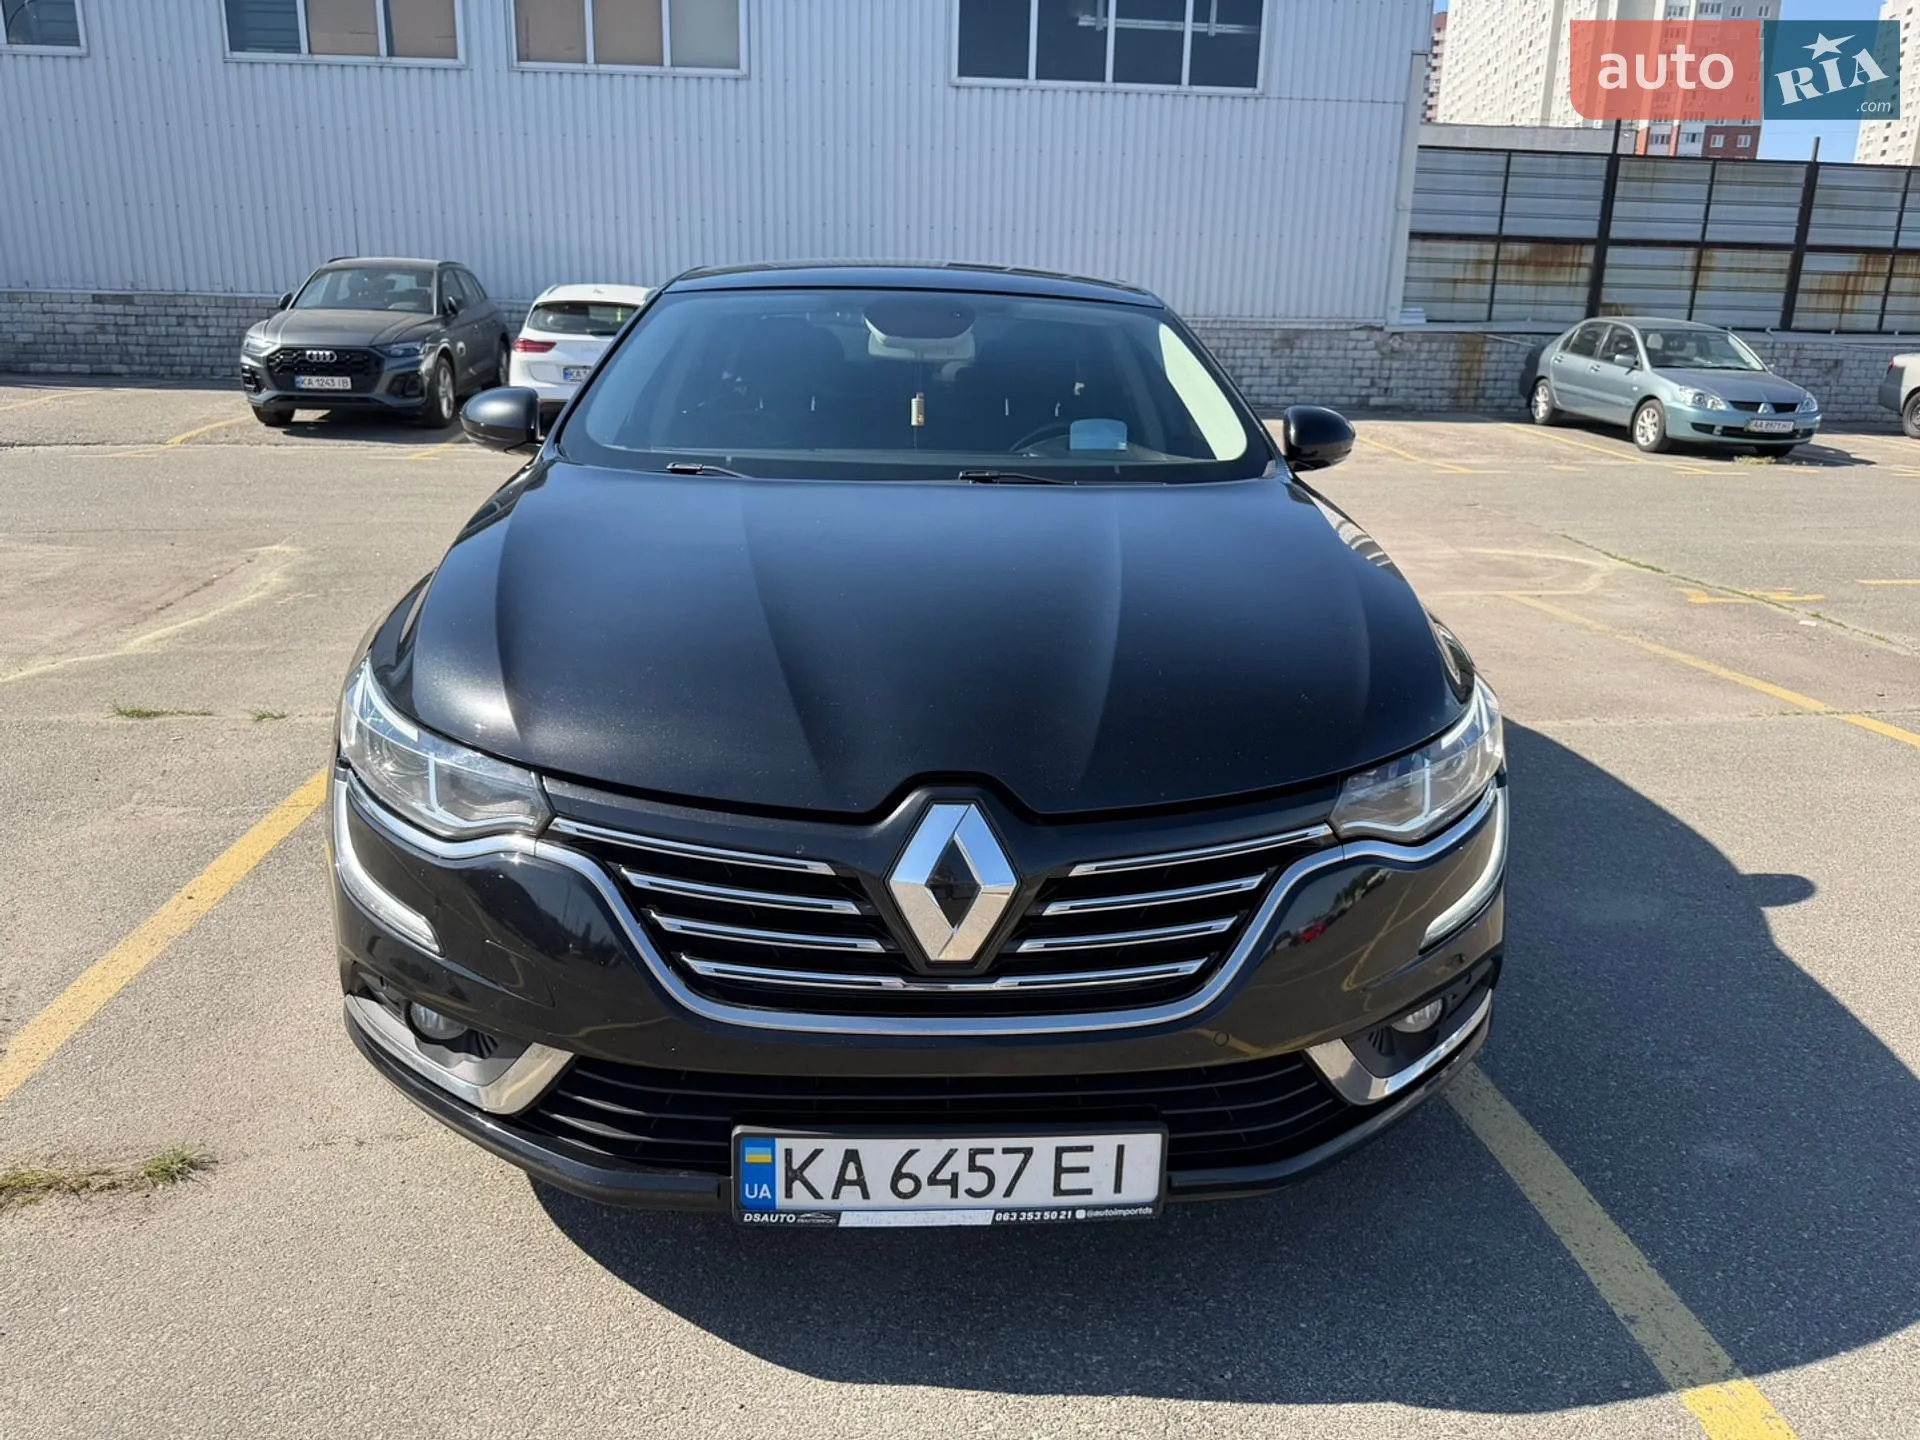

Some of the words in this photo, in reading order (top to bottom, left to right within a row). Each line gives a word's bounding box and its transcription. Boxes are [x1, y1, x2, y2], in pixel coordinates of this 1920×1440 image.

[301, 378, 314, 387] KA
[315, 378, 336, 388] 1243
[784, 1148, 870, 1200] KA
[890, 1147, 1034, 1200] 6457
[1052, 1144, 1125, 1197] EI
[745, 1183, 772, 1199] UA
[743, 1213, 796, 1223] DSAUTO
[995, 1211, 1017, 1221] 063
[1019, 1211, 1042, 1221] 353
[1043, 1210, 1058, 1220] 50
[1059, 1210, 1072, 1219] 21
